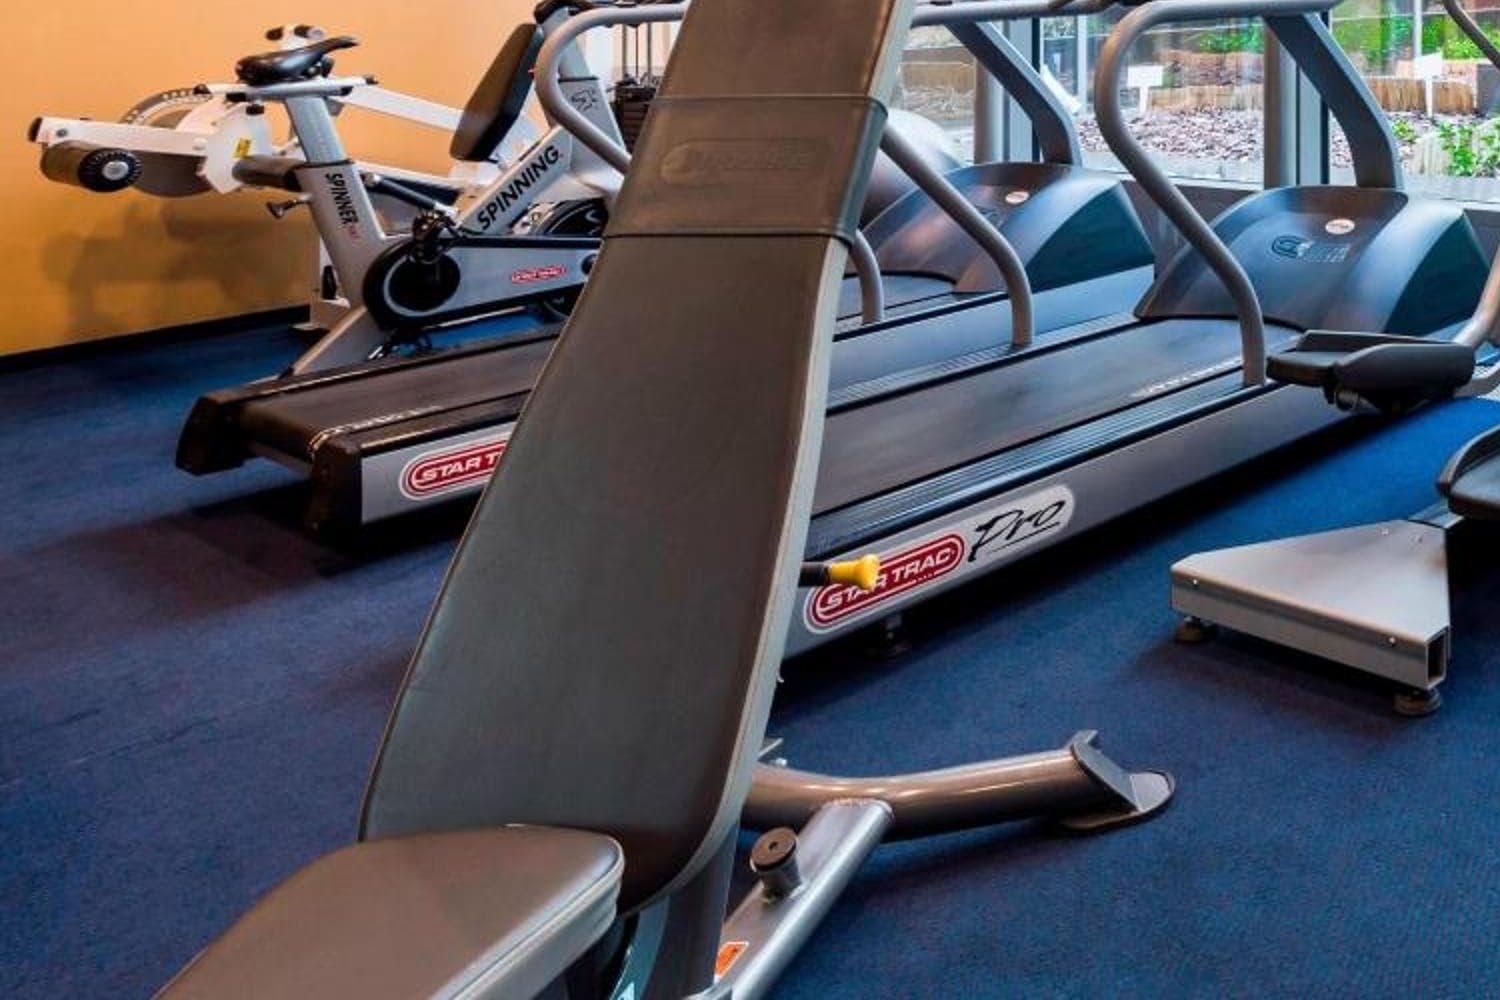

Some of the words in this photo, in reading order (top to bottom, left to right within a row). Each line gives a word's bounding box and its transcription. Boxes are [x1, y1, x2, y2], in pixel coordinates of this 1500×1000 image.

[325, 173, 359, 225] SPINNER
[477, 145, 561, 230] SPINNING
[422, 456, 482, 480] STAR
[891, 549, 951, 584] TRAC
[967, 500, 1066, 563] Pro
